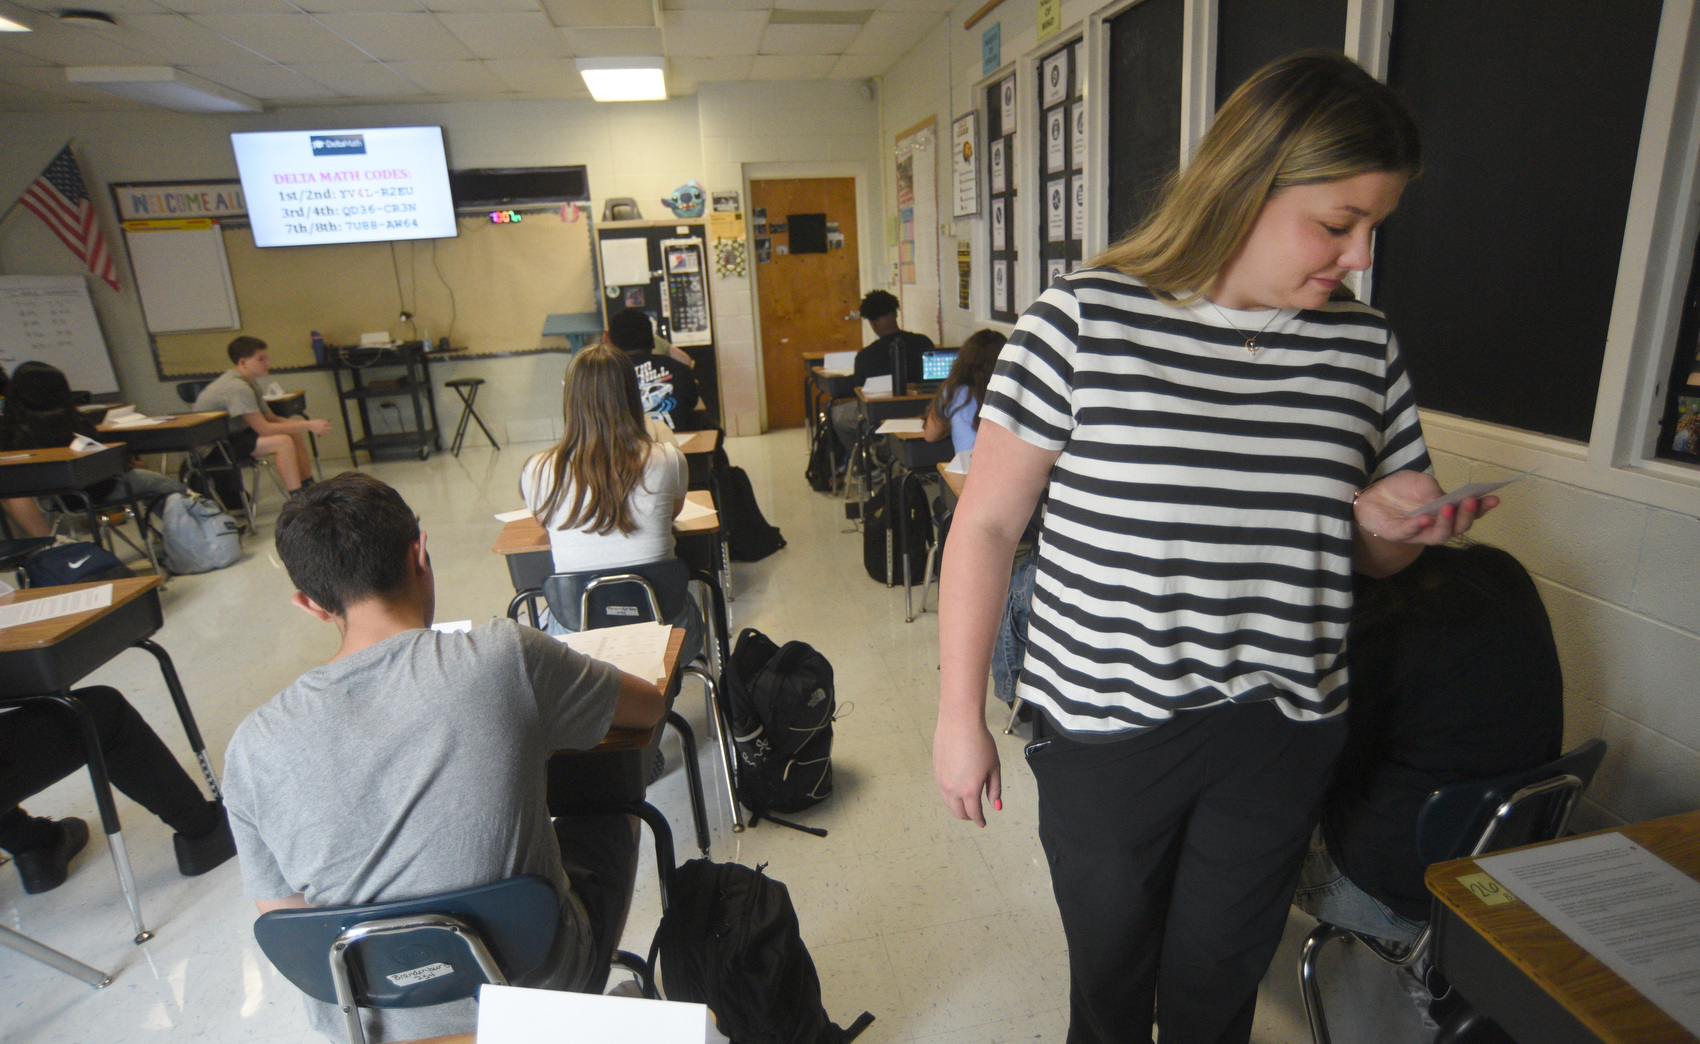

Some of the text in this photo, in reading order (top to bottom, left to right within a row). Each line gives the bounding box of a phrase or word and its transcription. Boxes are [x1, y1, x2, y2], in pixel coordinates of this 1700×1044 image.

[273, 168, 412, 185] DELTA MATH CODES:
[131, 190, 245, 214] WELCOME ALL
[278, 188, 336, 202] 1st/2nd:
[281, 205, 339, 220] 3rd/4th:
[285, 221, 342, 235] 7th/8th:
[1470, 881, 1499, 897] 26
